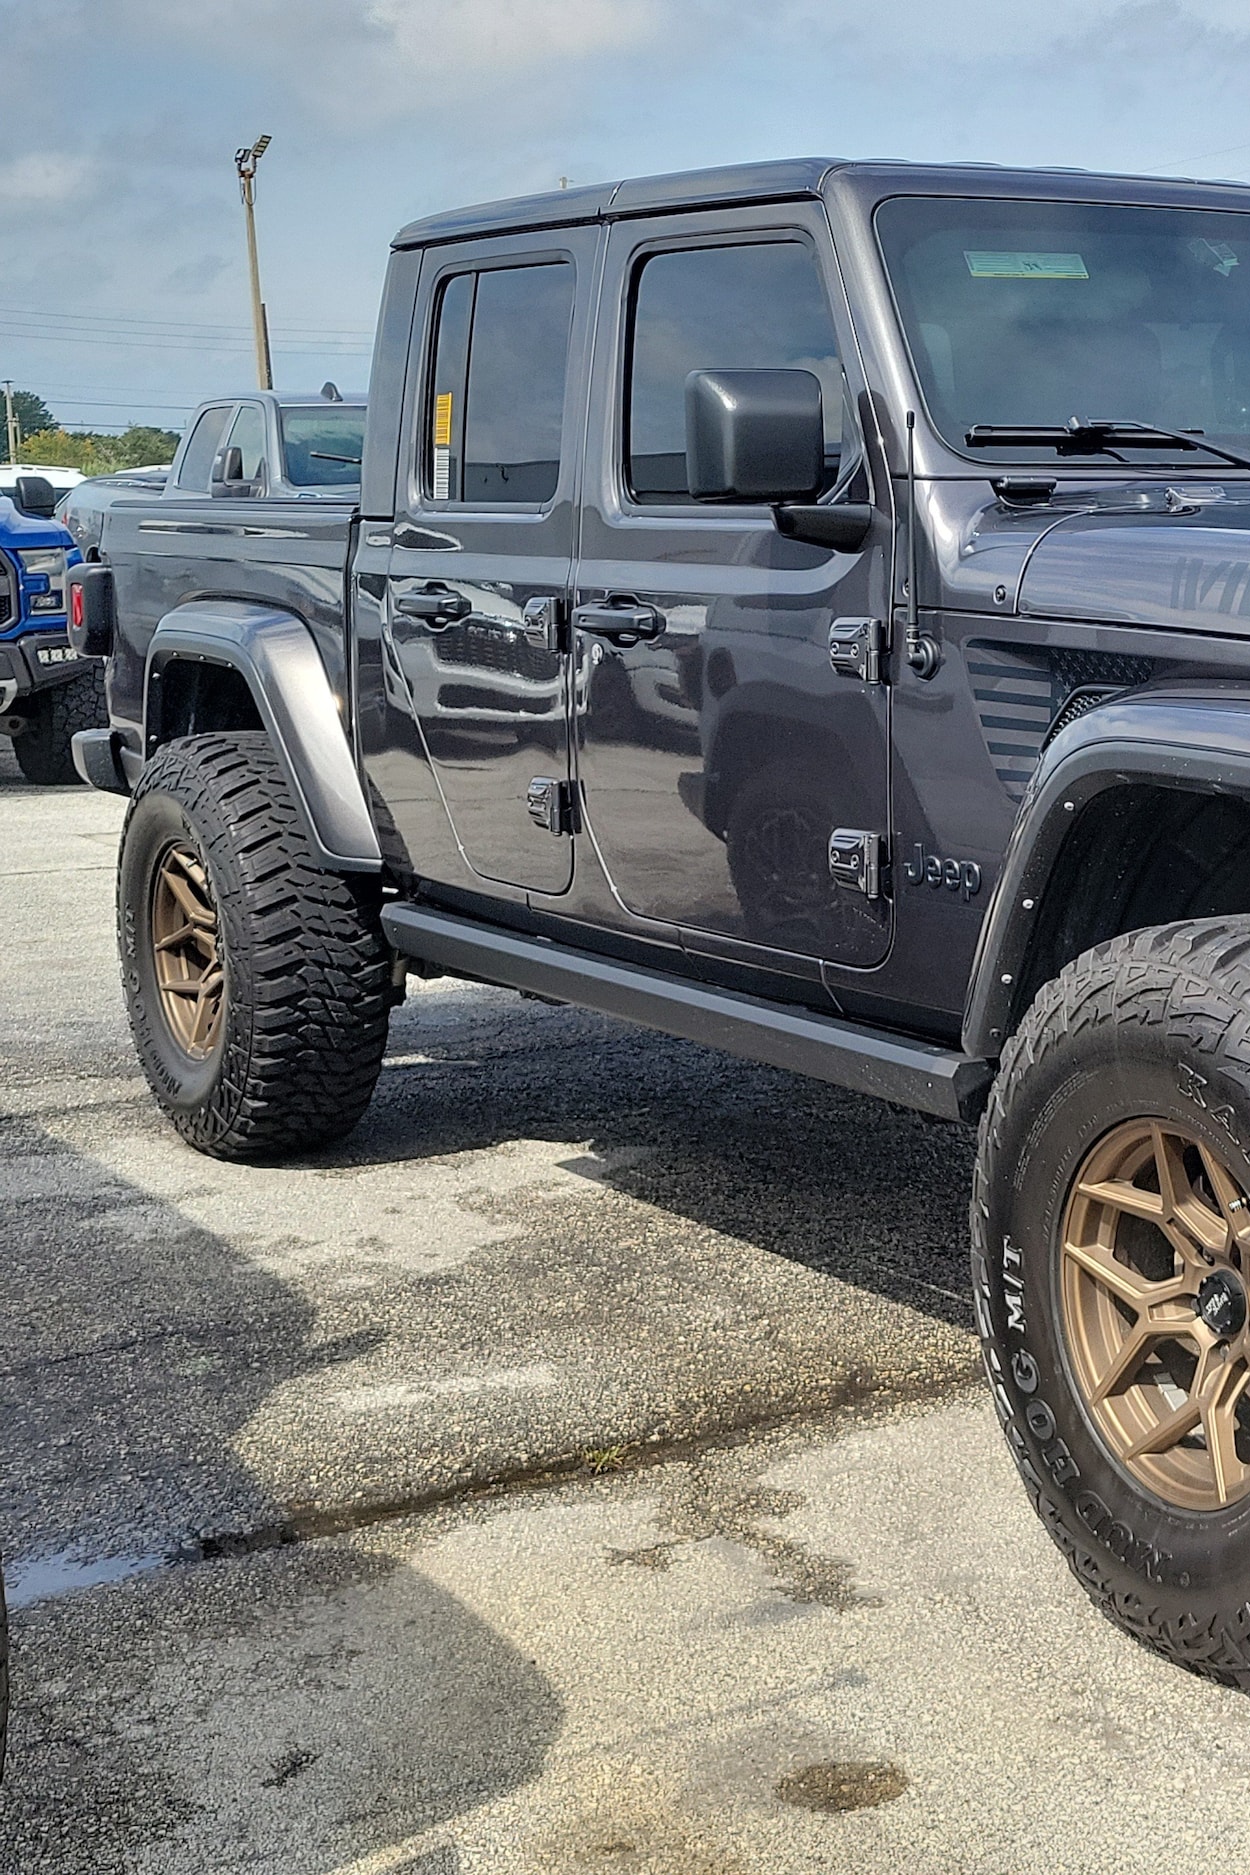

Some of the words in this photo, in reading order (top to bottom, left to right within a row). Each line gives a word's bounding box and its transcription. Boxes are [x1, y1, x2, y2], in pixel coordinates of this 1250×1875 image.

[903, 843, 981, 902] Jeep
[1002, 1234, 1027, 1334] M/T
[1011, 1348, 1081, 1489] HOG
[1076, 1490, 1173, 1583] MUD
